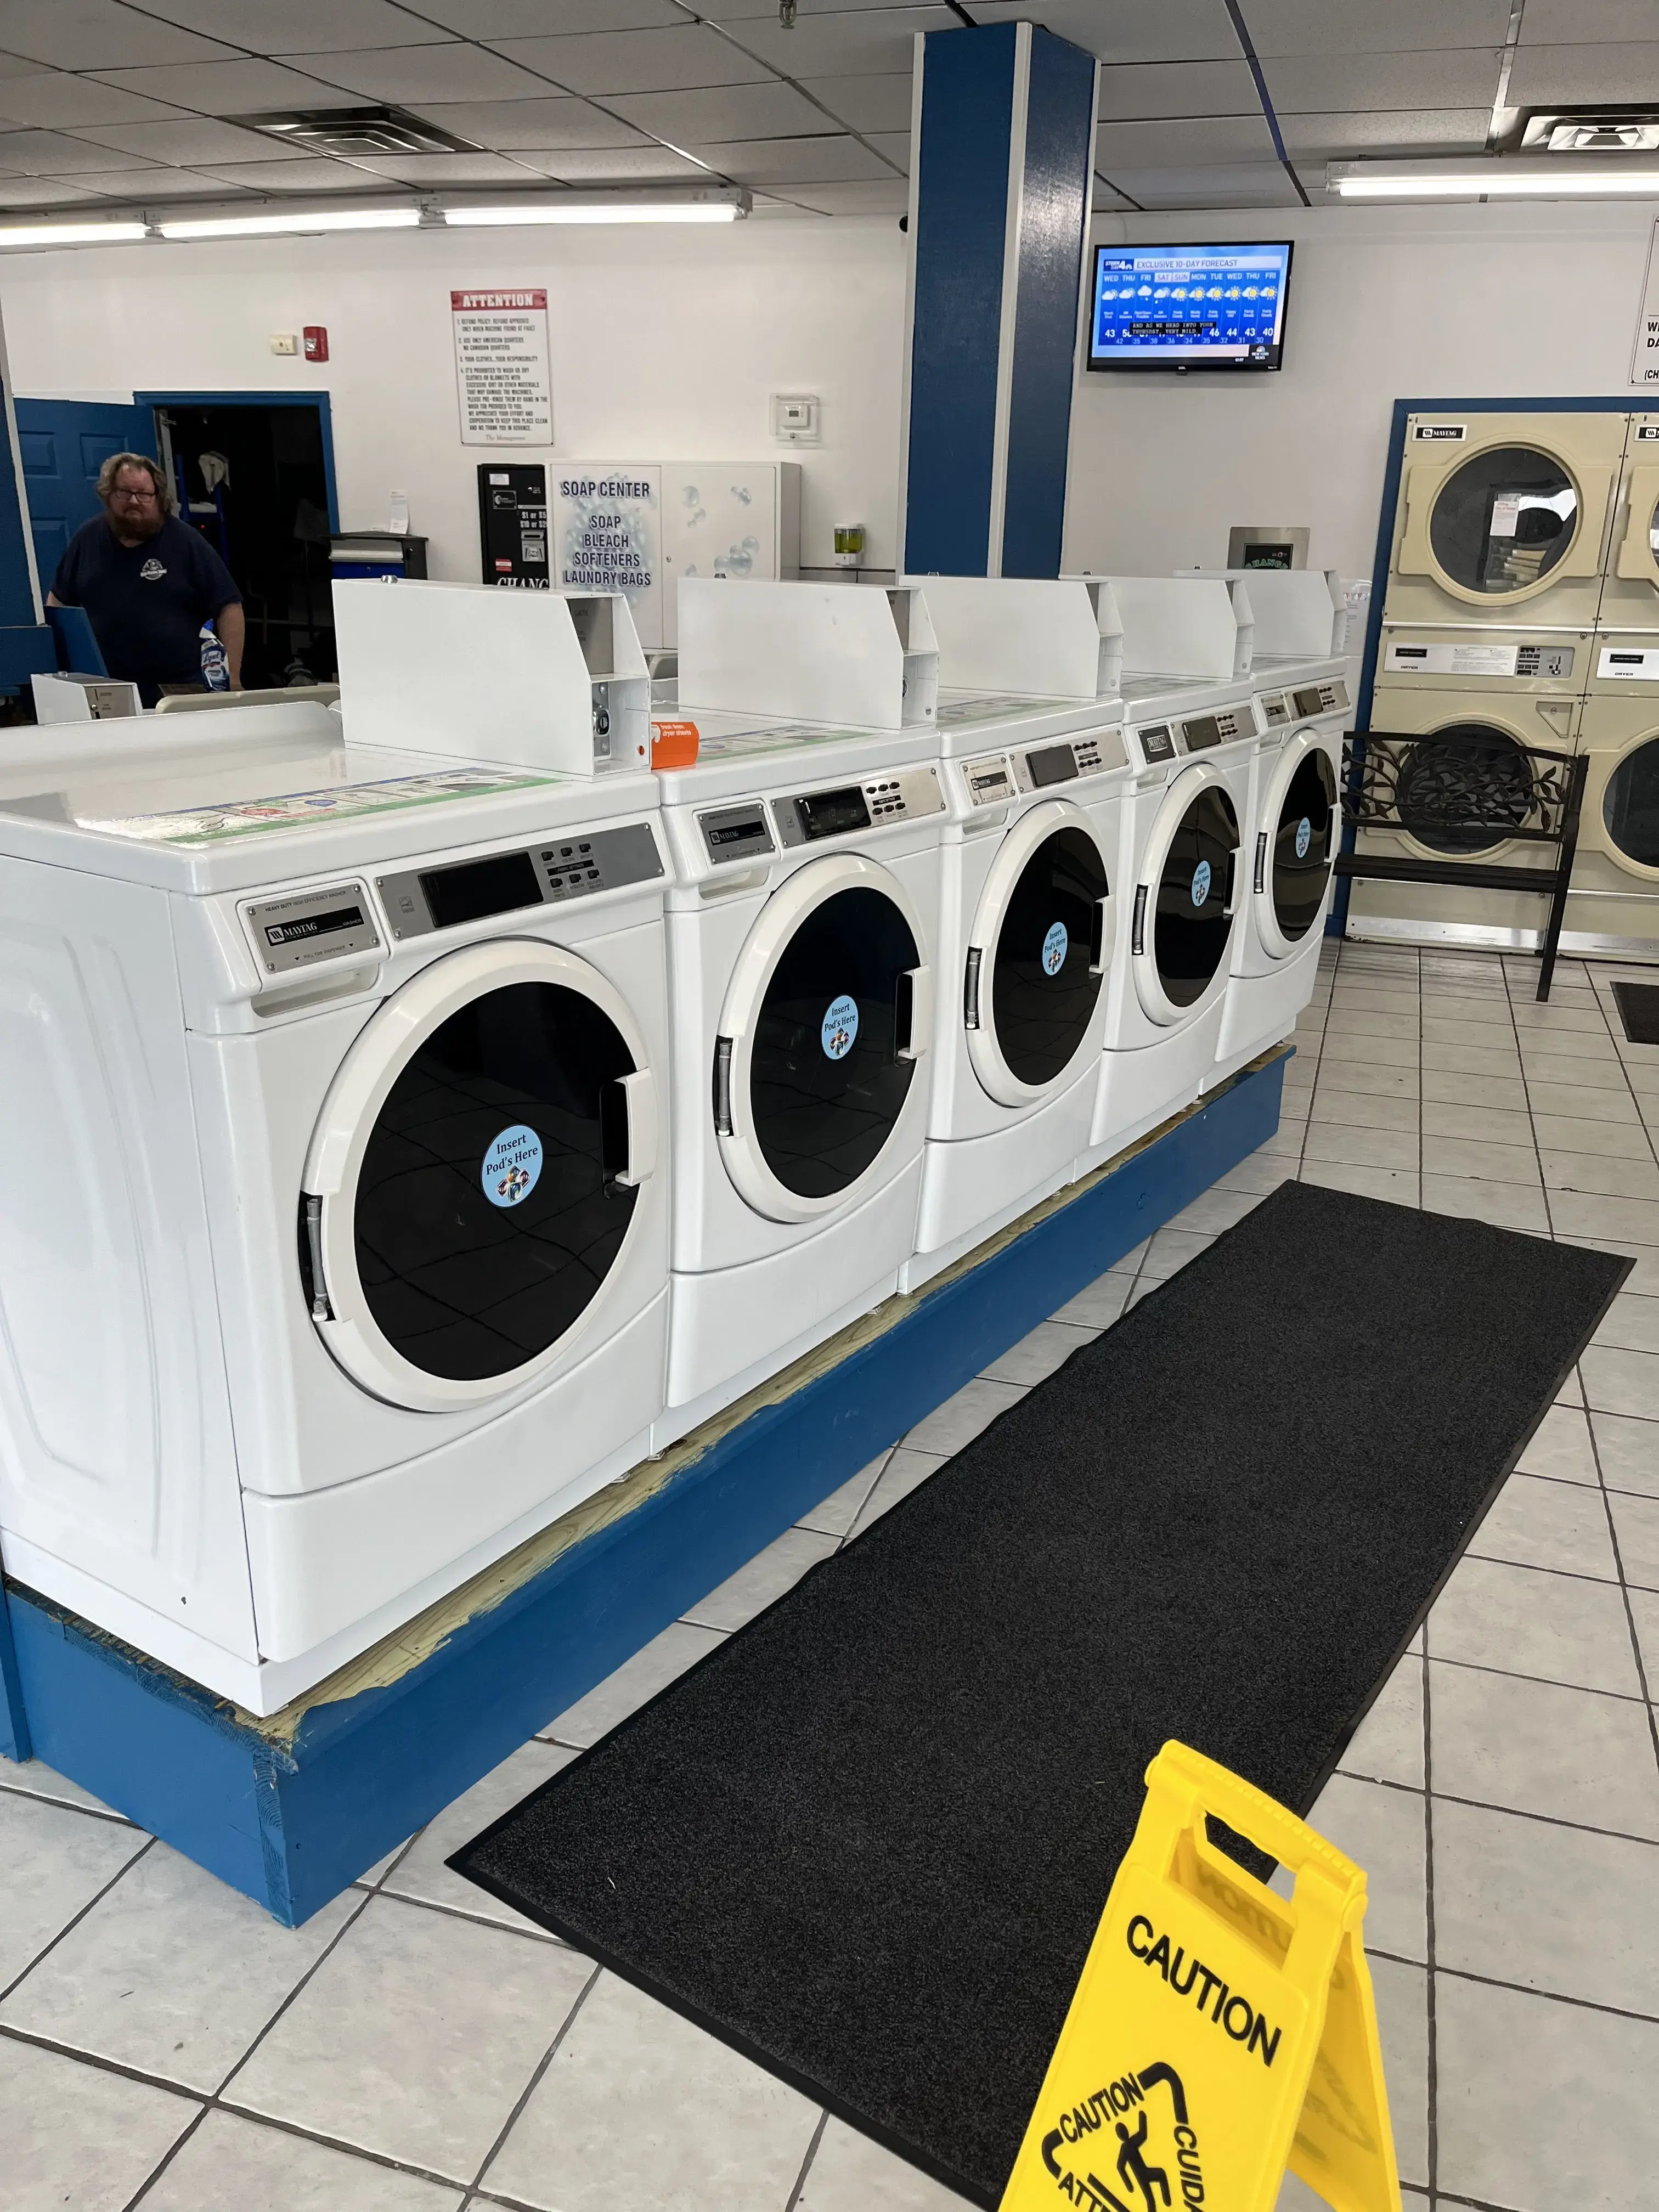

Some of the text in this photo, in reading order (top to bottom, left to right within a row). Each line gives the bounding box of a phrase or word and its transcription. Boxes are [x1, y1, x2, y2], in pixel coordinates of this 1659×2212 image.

[462, 294, 533, 307] ATTENTION
[1105, 329, 1115, 337] 43
[1209, 328, 1273, 337] 46 44 43 40
[1648, 322, 1659, 331] W
[1645, 370, 1659, 381] (CH
[563, 481, 650, 496] SOAP CENTER
[591, 515, 621, 528] SOAP
[585, 534, 628, 548] BLEACH
[574, 552, 640, 567] SOFTENERS
[565, 570, 651, 585] LAUNDRY BAGS
[305, 895, 328, 904] EFFICIENCY
[284, 922, 317, 937] MAYTAG
[1049, 929, 1062, 940] Insert
[1044, 938, 1066, 953] Pod's Here
[832, 1003, 850, 1016] Insert
[825, 1014, 856, 1032] Pod's Here
[496, 1135, 526, 1154] Insert
[486, 1147, 538, 1176] Pod's Here
[1126, 1915, 1283, 2068] CAUTION
[1059, 2072, 1144, 2143] CAUTION
